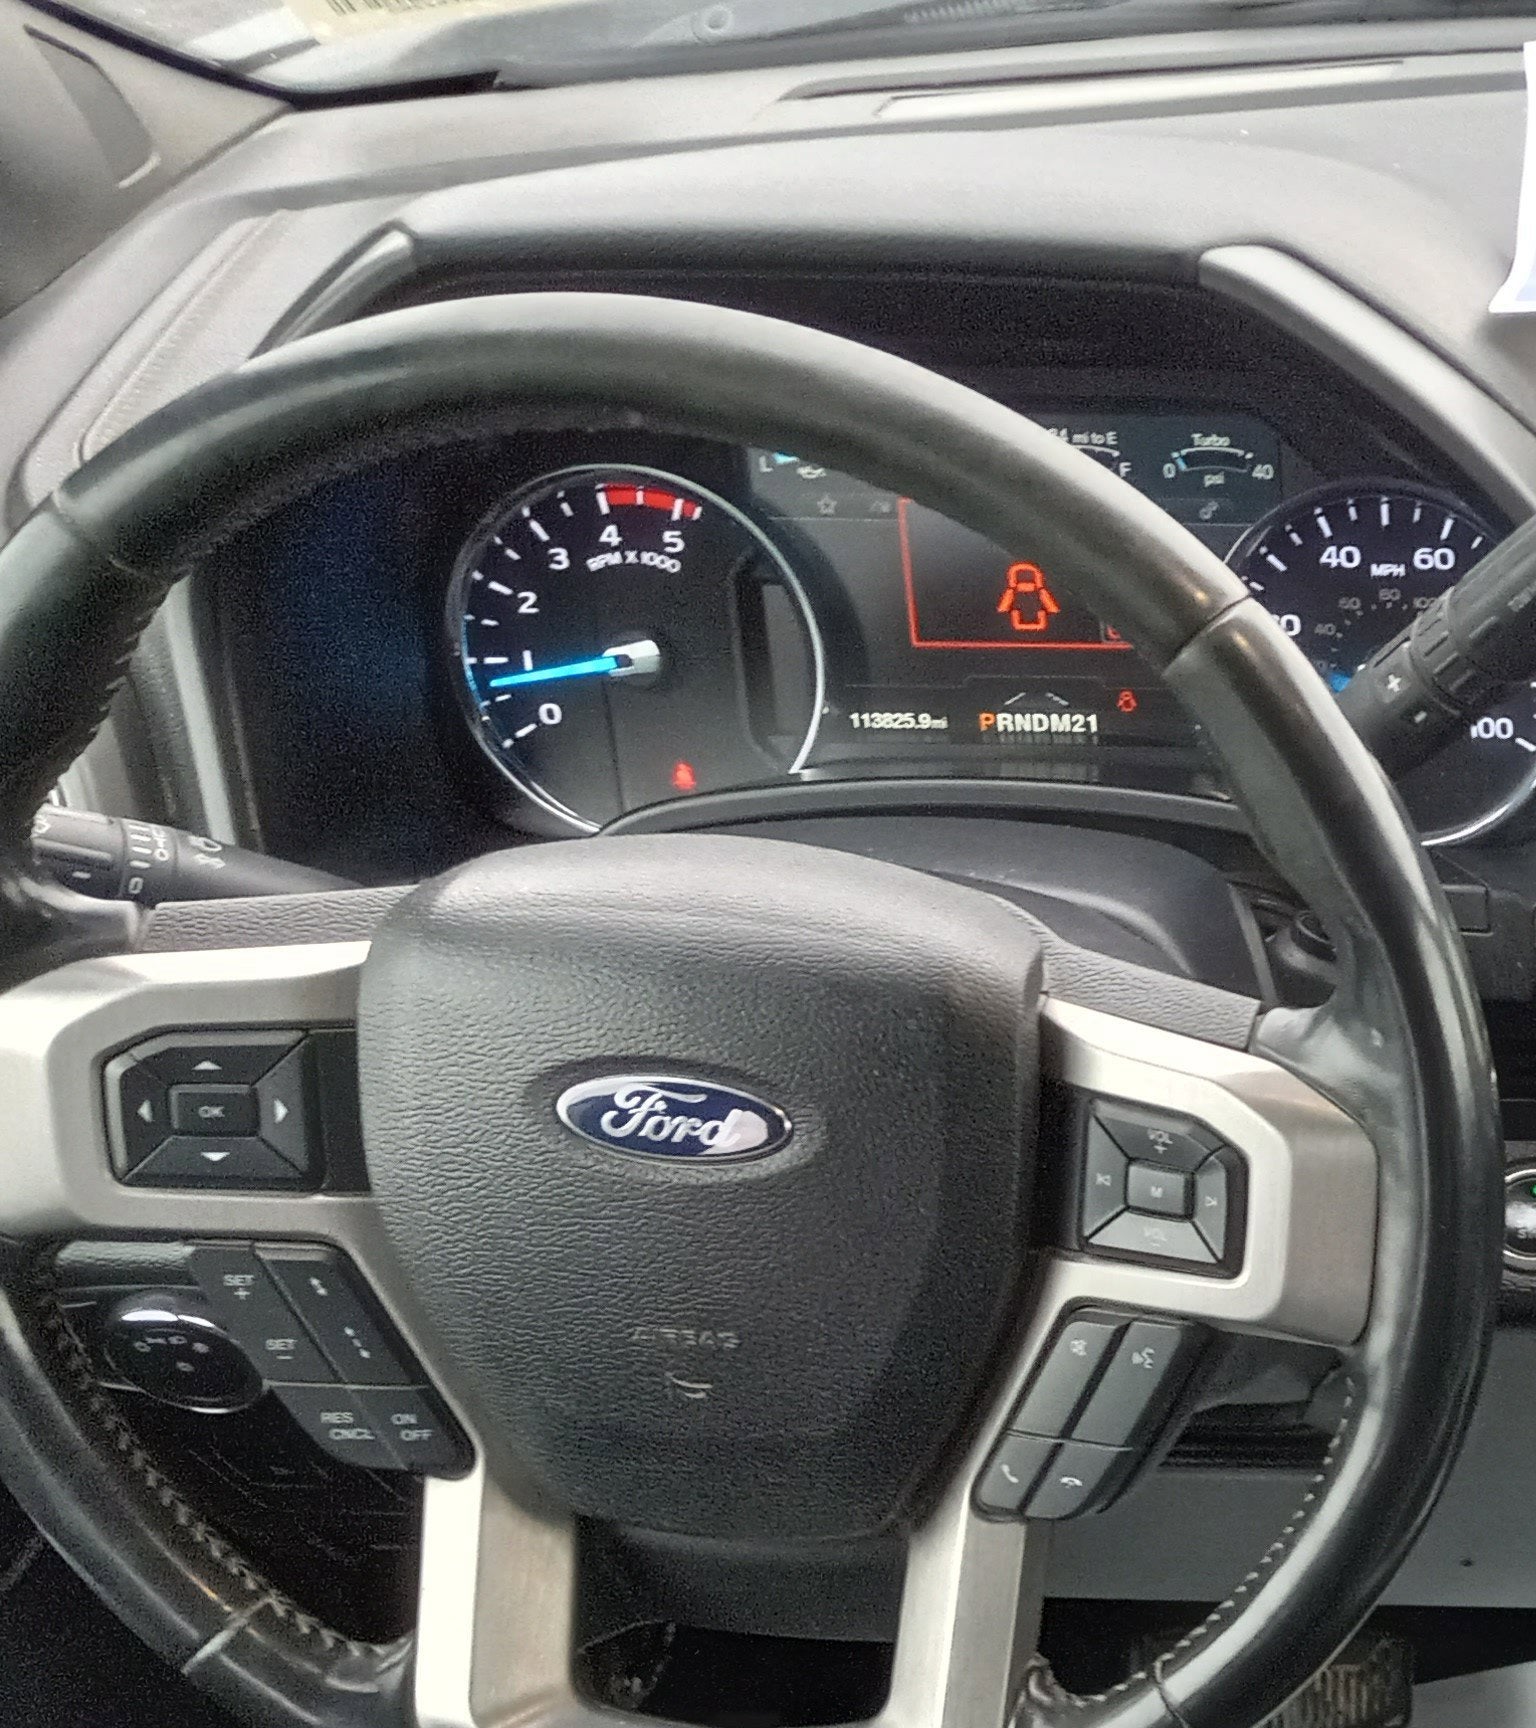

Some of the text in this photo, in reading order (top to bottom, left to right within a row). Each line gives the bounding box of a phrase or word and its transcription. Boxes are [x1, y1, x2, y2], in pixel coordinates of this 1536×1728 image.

[1106, 431, 1119, 445] E
[1191, 432, 1231, 447] Turbo
[1119, 462, 1132, 477] F
[1252, 464, 1275, 480] 40
[1204, 472, 1225, 487] psi
[599, 525, 623, 546] 4
[663, 531, 685, 554] 5
[548, 549, 570, 570] 3
[1319, 545, 1362, 569] 40
[1413, 547, 1456, 571] 60
[1370, 563, 1406, 578] MPH
[517, 593, 539, 613] 2
[523, 650, 533, 671] 1
[539, 703, 562, 724] 0
[199, 1106, 225, 1119] OK
[600, 1083, 742, 1149] Ford
[224, 1274, 254, 1287] SET
[265, 1338, 297, 1352] SET
[320, 1412, 417, 1425] RES ON
[329, 1428, 433, 1442] CNCL OFF
